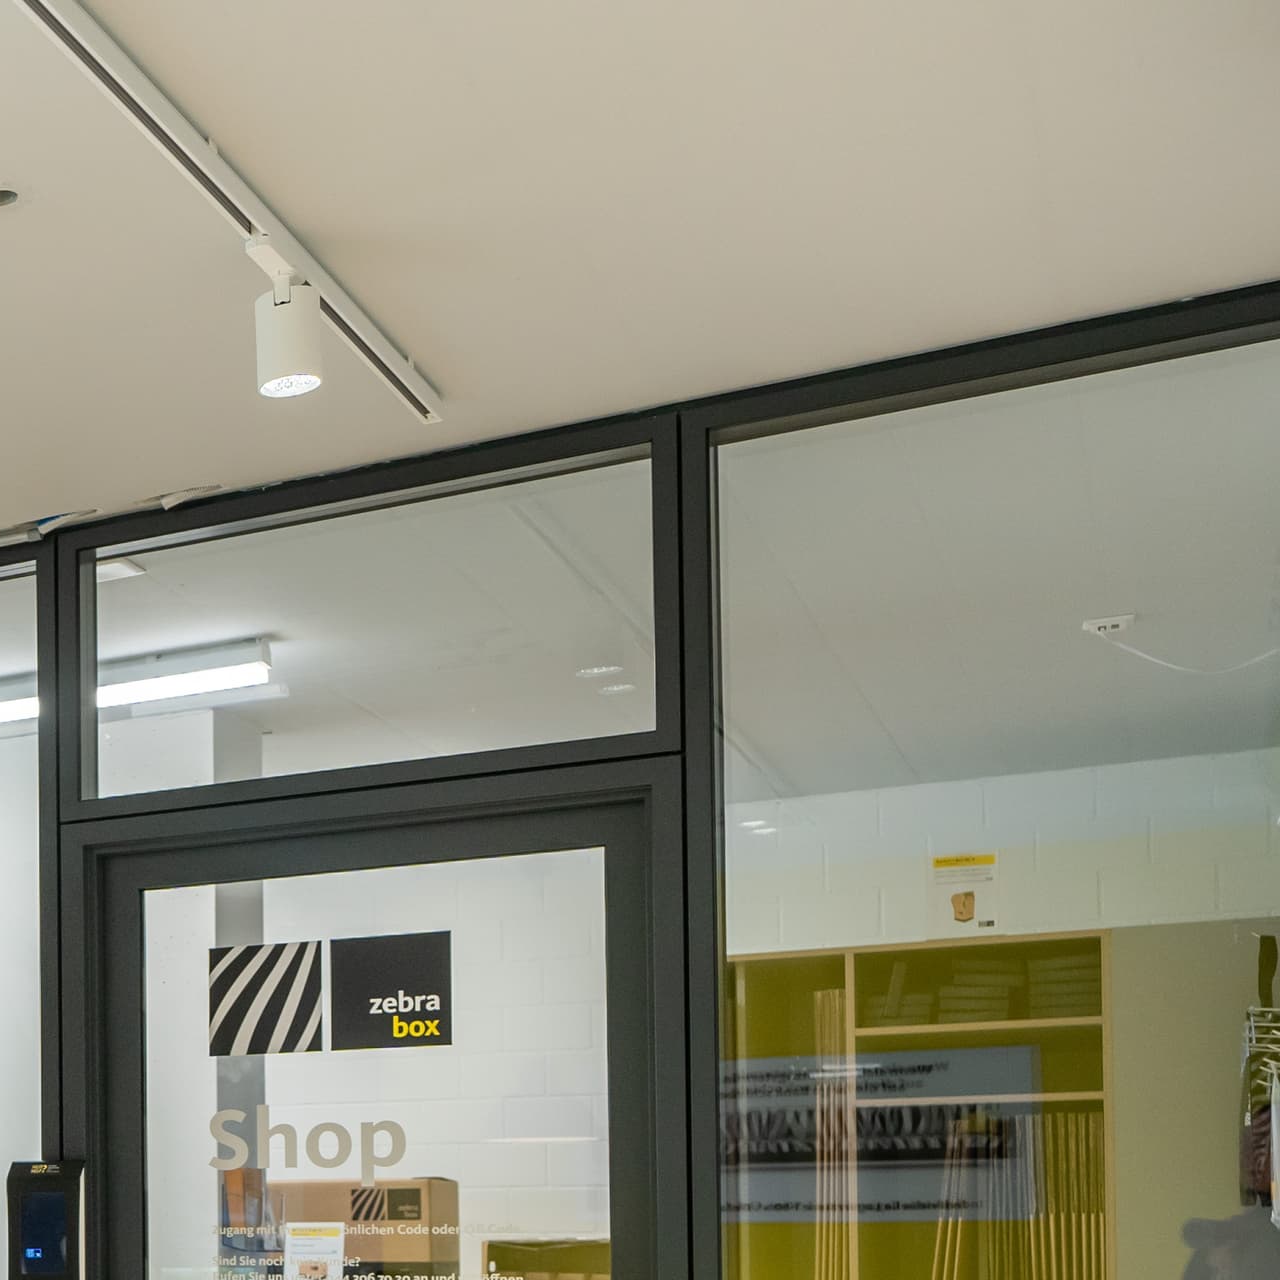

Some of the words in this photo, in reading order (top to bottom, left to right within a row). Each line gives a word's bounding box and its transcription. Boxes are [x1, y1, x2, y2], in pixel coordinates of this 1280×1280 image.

[369, 990, 440, 1015] zebra
[392, 1015, 440, 1038] box
[208, 1104, 407, 1188] Shop
[397, 1223, 429, 1236] Code
[432, 1223, 460, 1236] oder
[239, 1256, 257, 1267] Sie
